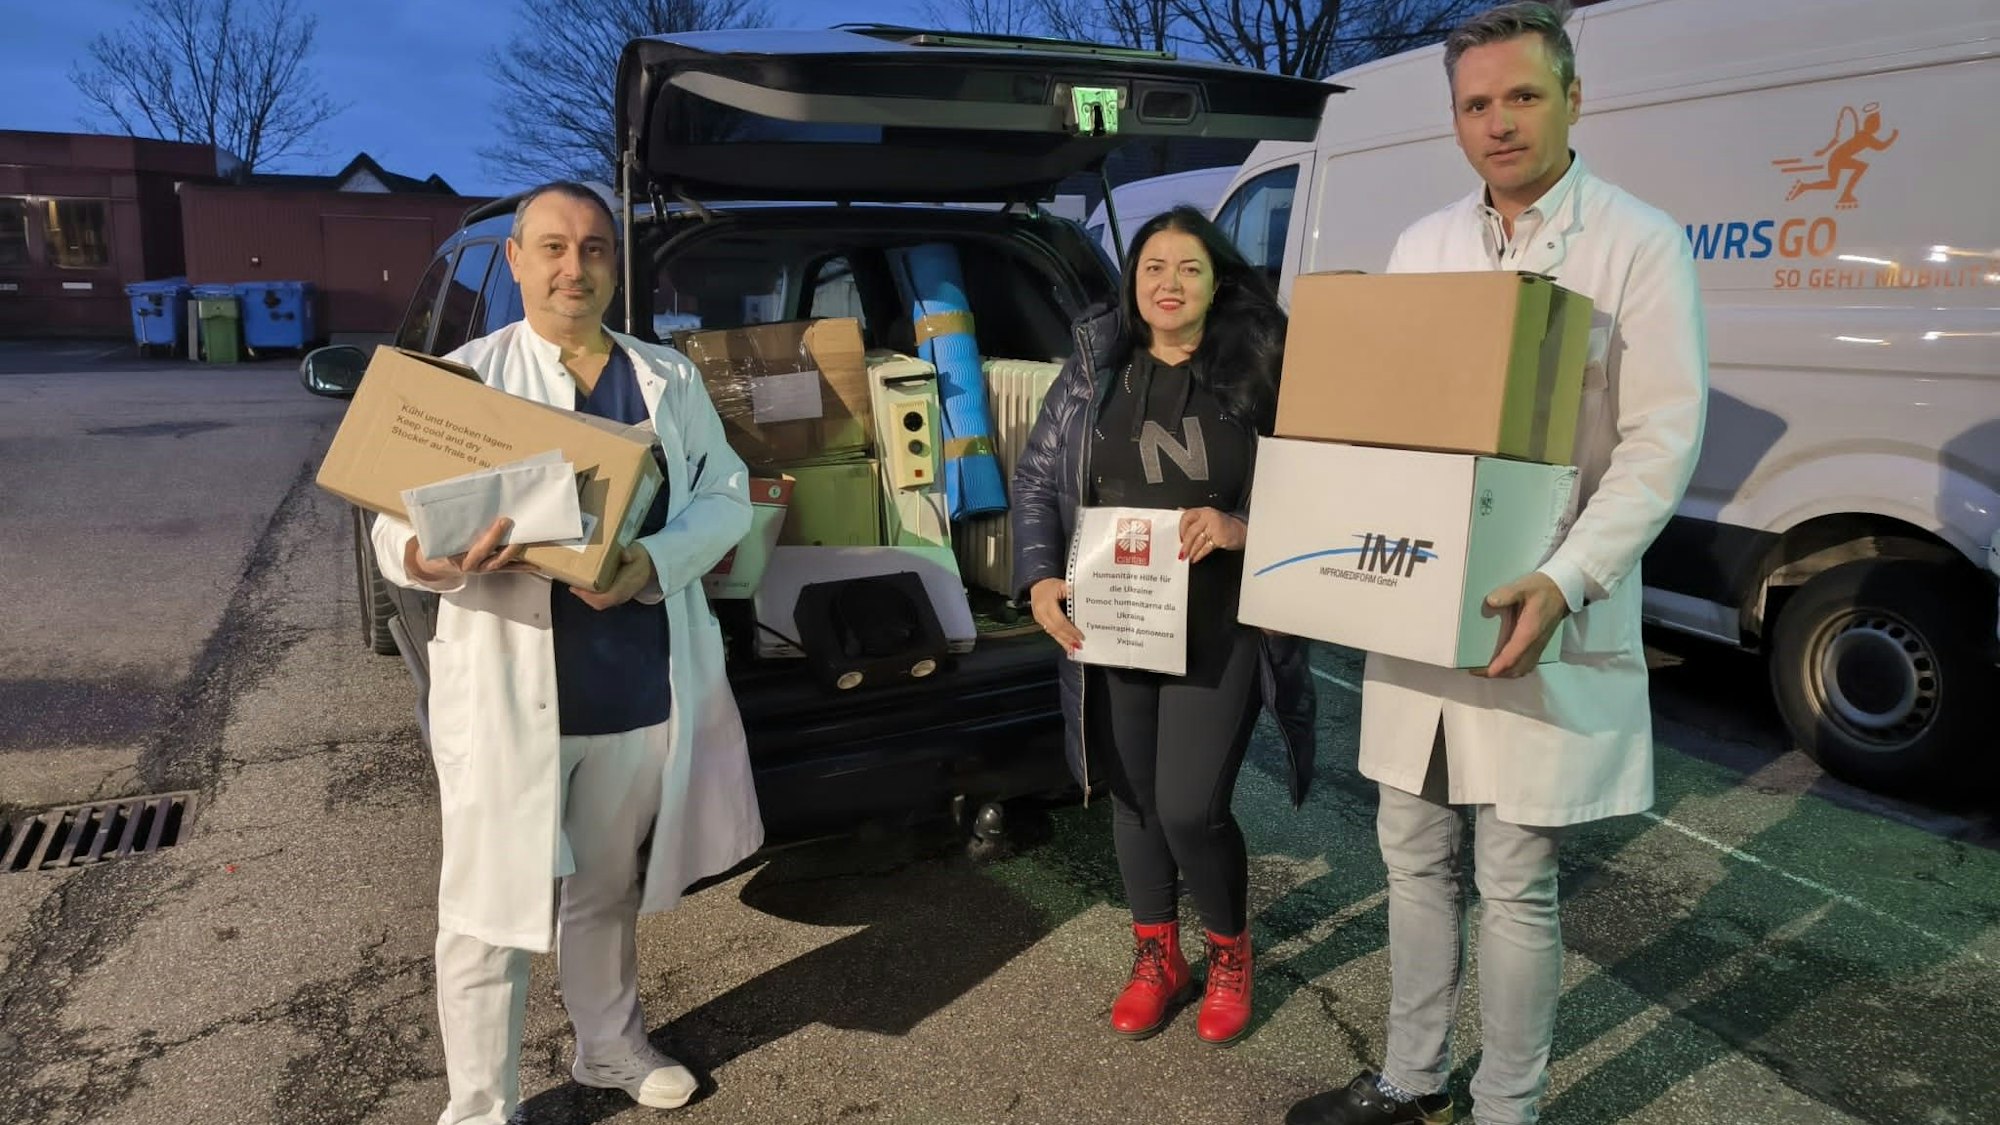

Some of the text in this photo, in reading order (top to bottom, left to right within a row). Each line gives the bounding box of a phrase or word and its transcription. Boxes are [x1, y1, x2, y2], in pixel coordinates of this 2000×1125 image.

[1774, 269, 1800, 288] SO
[1808, 268, 1867, 287] GEHT
[396, 414, 482, 453] Keep cool and dry
[401, 403, 513, 451] Kühl und trocken lagern
[391, 426, 491, 469] Stocker au frais et au
[1139, 416, 1209, 484] N
[1357, 533, 1434, 577] IMF
[1092, 571, 1138, 581] Humanitäre
[1159, 574, 1172, 584] für
[1109, 585, 1154, 596] die Ukraine
[1319, 567, 1398, 587] IMPROMEDIFORM GmbH
[1086, 597, 1176, 612] Pomoc humanitarna dla
